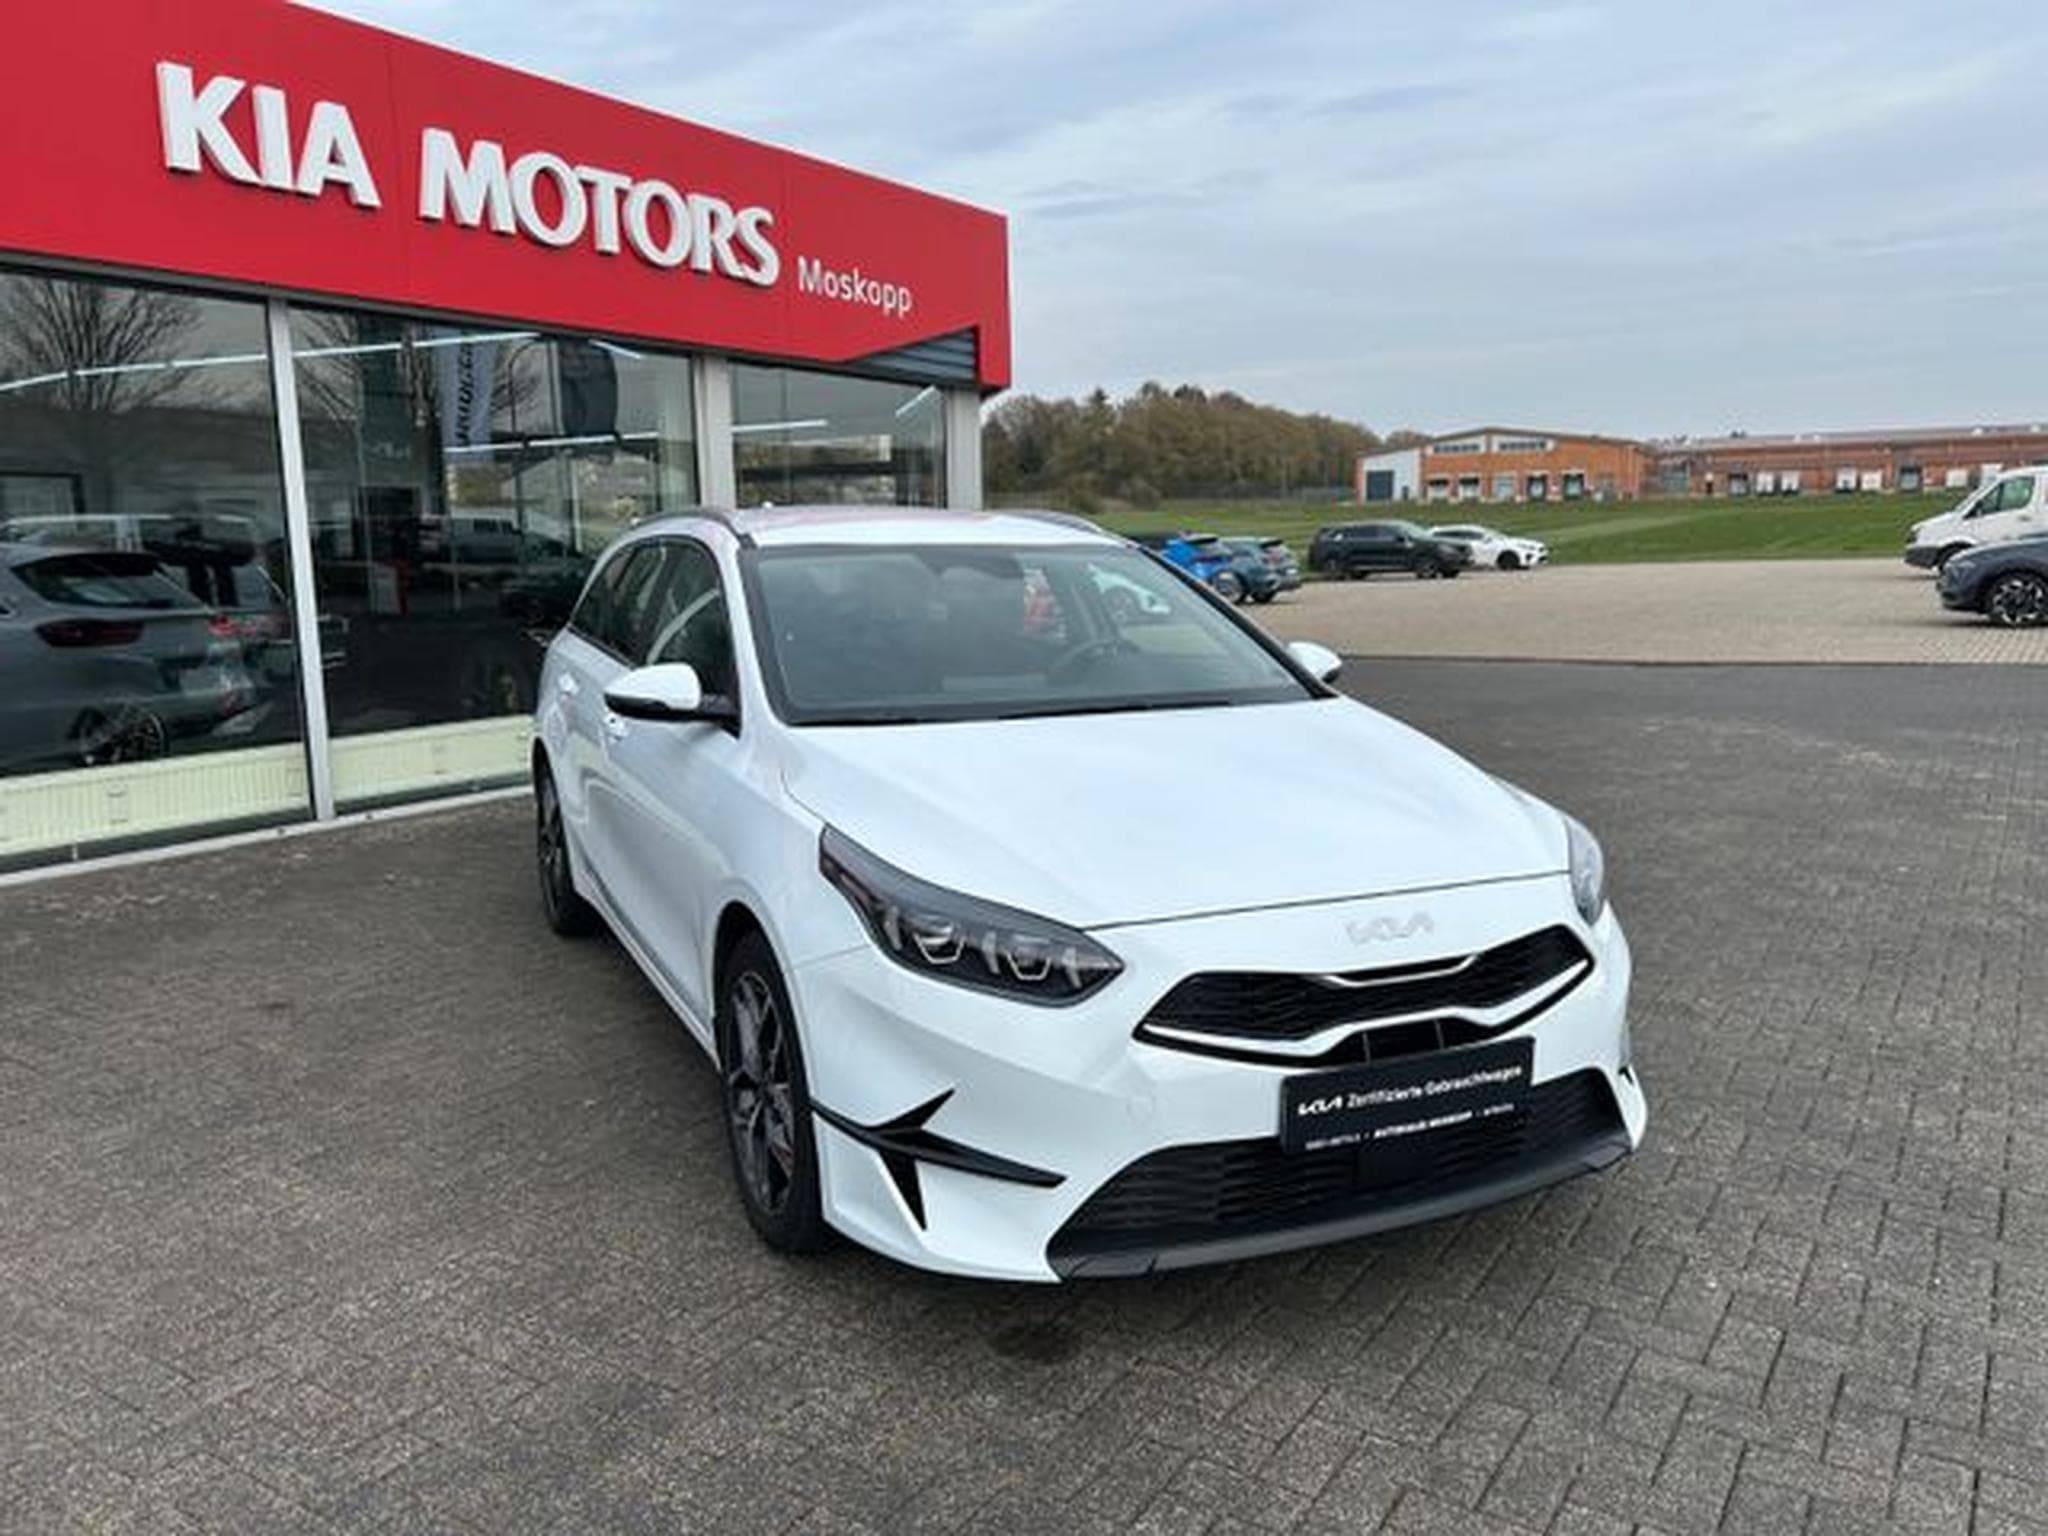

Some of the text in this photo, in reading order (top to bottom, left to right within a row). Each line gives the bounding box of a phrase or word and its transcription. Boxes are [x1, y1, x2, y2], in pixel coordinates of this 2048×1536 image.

[156, 61, 781, 287] KIA MOTORS
[797, 257, 913, 317] Moskopp
